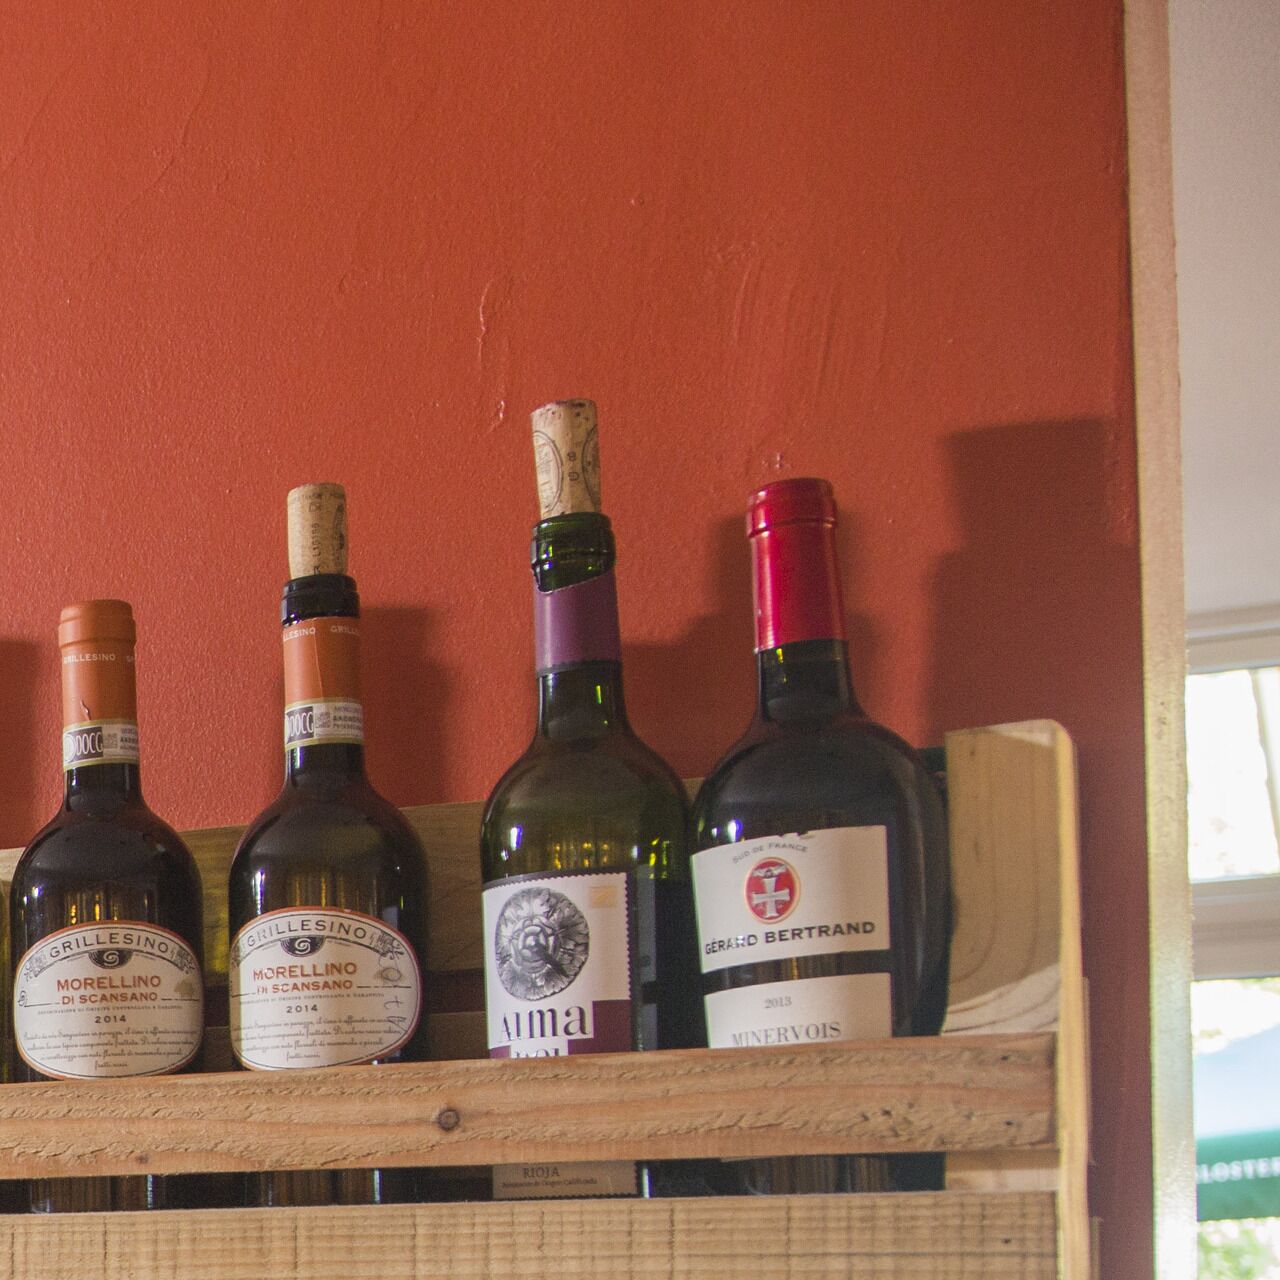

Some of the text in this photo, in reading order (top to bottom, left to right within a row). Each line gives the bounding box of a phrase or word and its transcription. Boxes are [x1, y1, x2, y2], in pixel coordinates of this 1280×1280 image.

[732, 842, 809, 865] SUD DE FRANCE
[245, 918, 367, 948] GRILLESINO
[704, 920, 876, 955] GÉRARD BERTRAND
[48, 932, 170, 959] GRILLESINO
[252, 961, 358, 982] MORELLINO
[56, 974, 162, 993] MORELLINO
[271, 979, 354, 994] SCANSANO
[61, 991, 159, 1006] DI SCANSANO
[764, 996, 793, 1010] 2013
[286, 1004, 319, 1015] 2014
[94, 1014, 128, 1025] 2014
[731, 1021, 842, 1047] MINERVOIS
[522, 1166, 560, 1179] RIOJA
